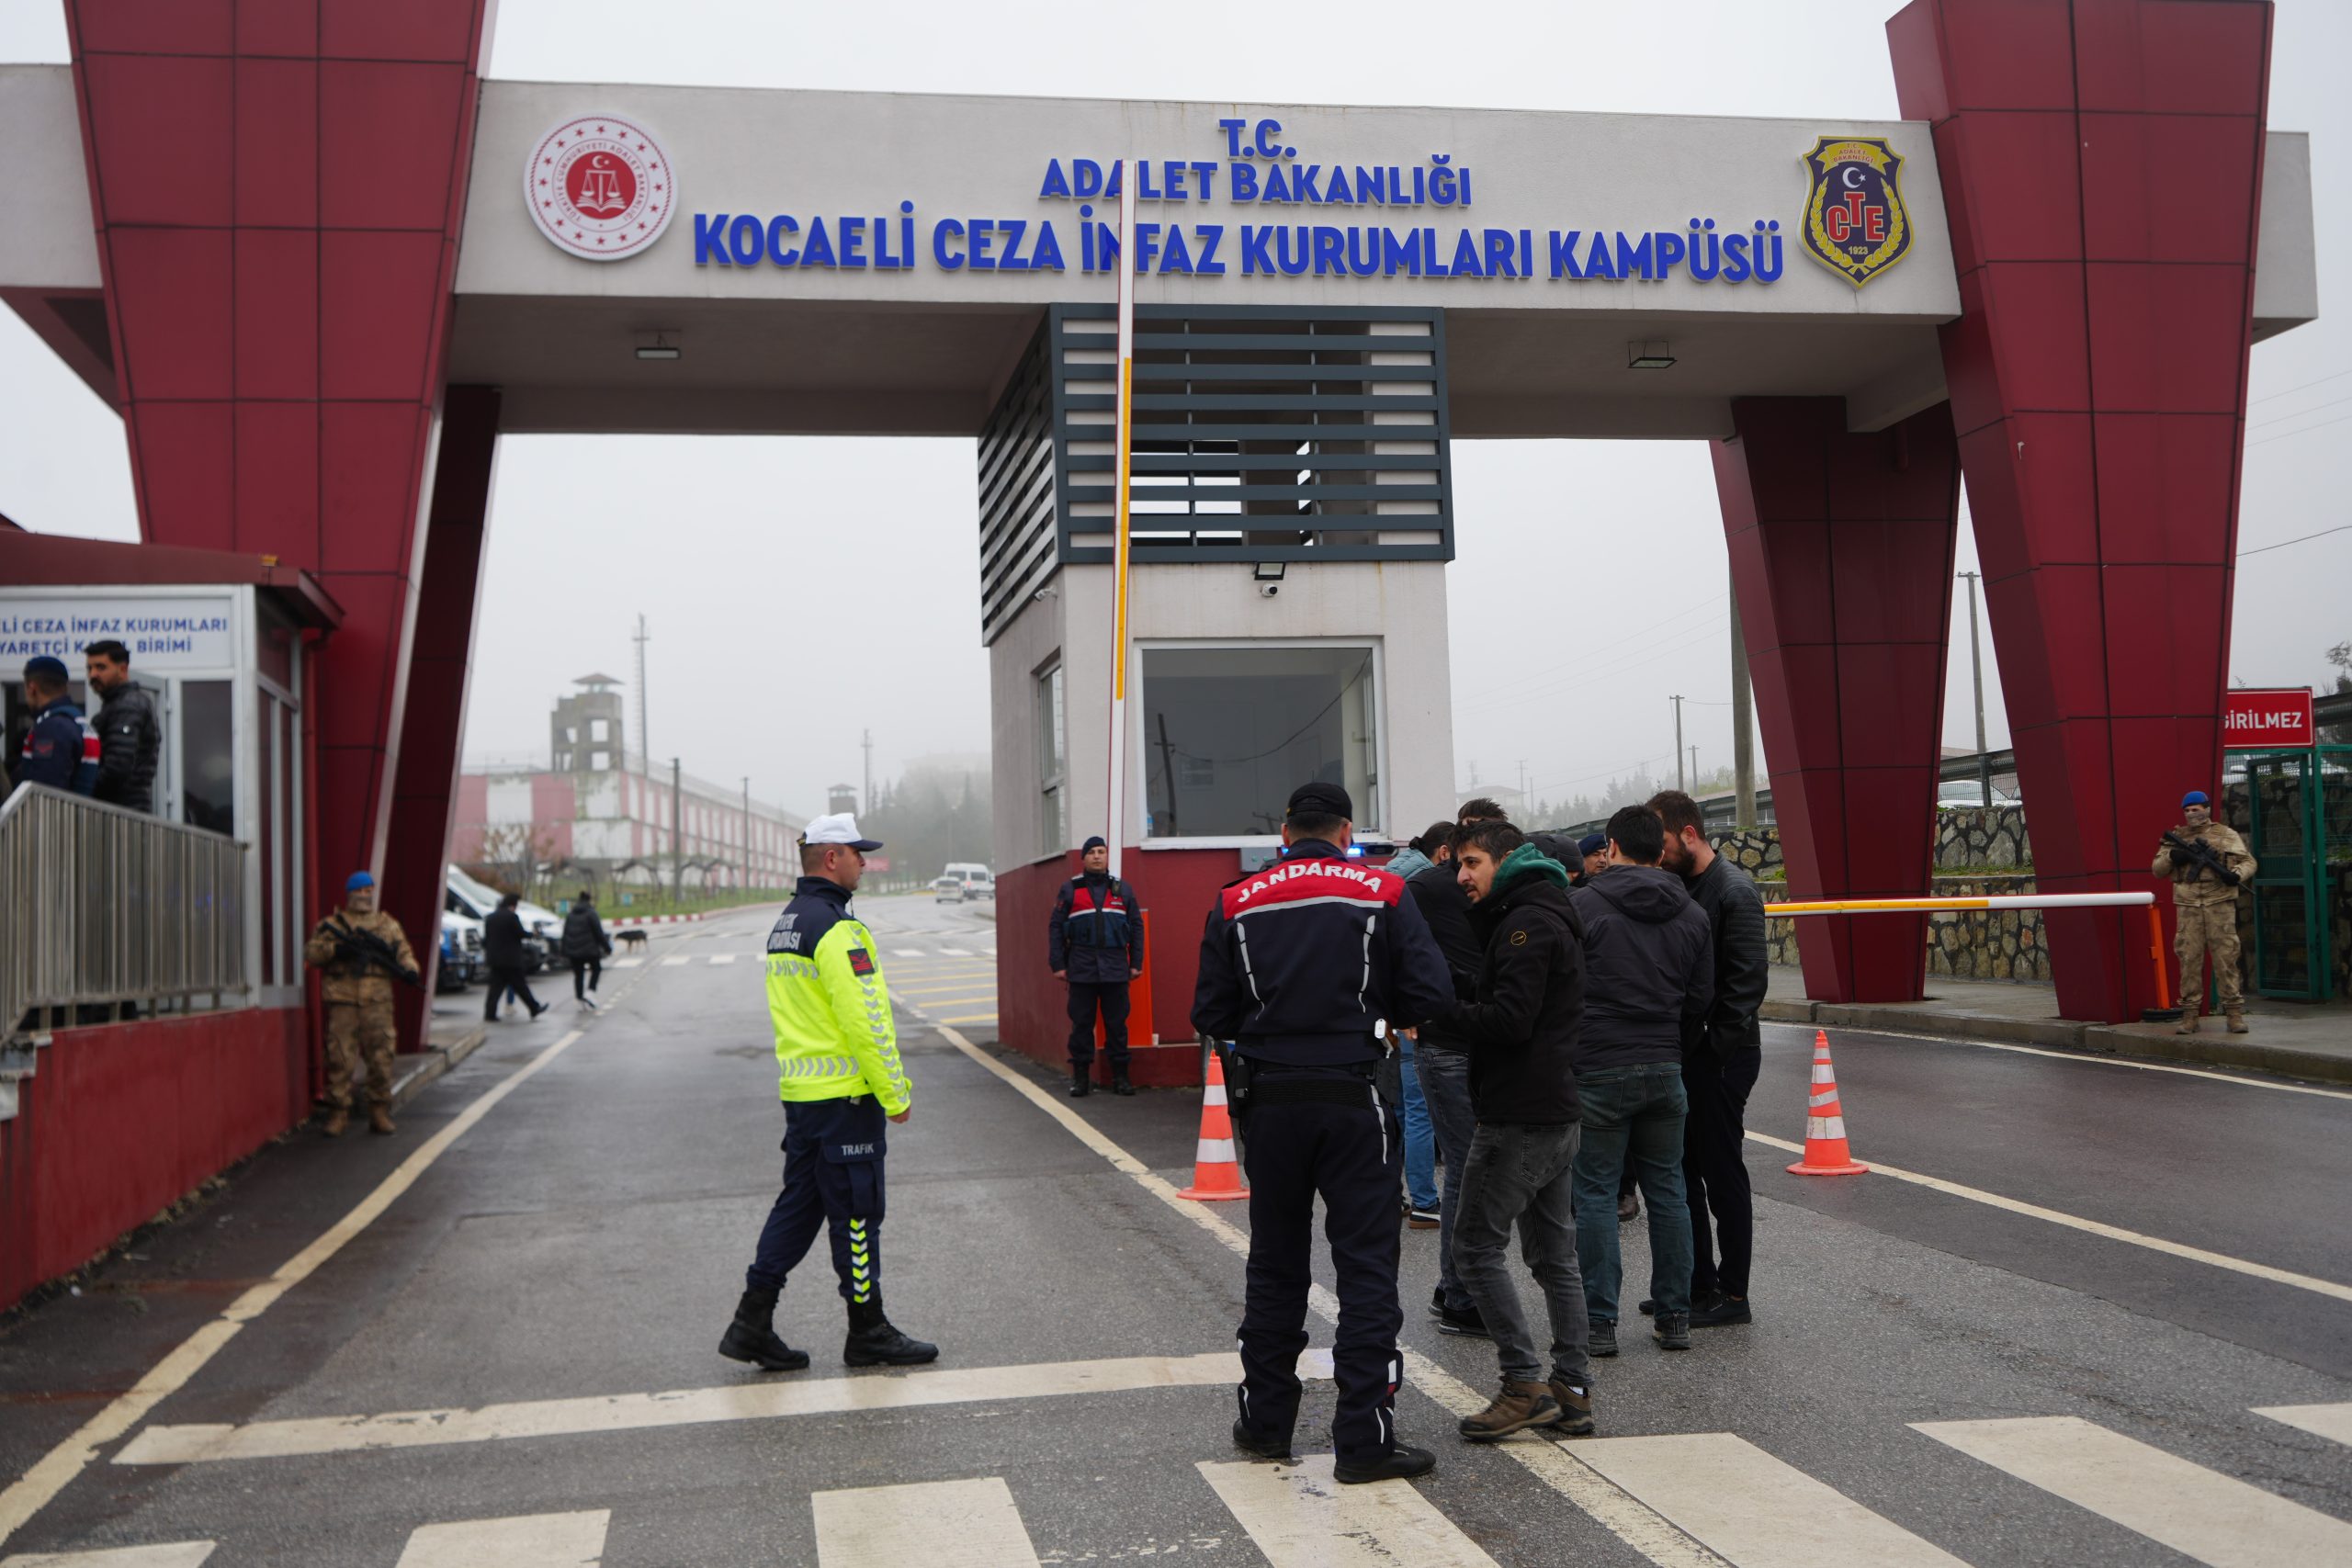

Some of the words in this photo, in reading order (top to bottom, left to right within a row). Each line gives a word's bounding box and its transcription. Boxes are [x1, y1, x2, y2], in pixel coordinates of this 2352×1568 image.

[1219, 118, 1297, 158] T.C.
[1040, 158, 1218, 201] ADALET
[1231, 154, 1472, 205] BAKANLIĞI
[1826, 192, 1885, 243] CTE
[695, 200, 915, 269] KOCAELİ
[933, 218, 1067, 270] CEZA
[1080, 204, 1227, 274] İNFAZ
[1240, 224, 1533, 276] KURUMLARI
[1549, 218, 1783, 282] KAMPÜSÜ
[1848, 245, 1869, 255] 1923
[22, 618, 66, 634] CEZA
[71, 615, 121, 633] İNFAZ
[125, 617, 228, 633] KURUMLARI
[136, 636, 192, 653] BİRİMİ
[1237, 862, 1383, 903] JANDARMA
